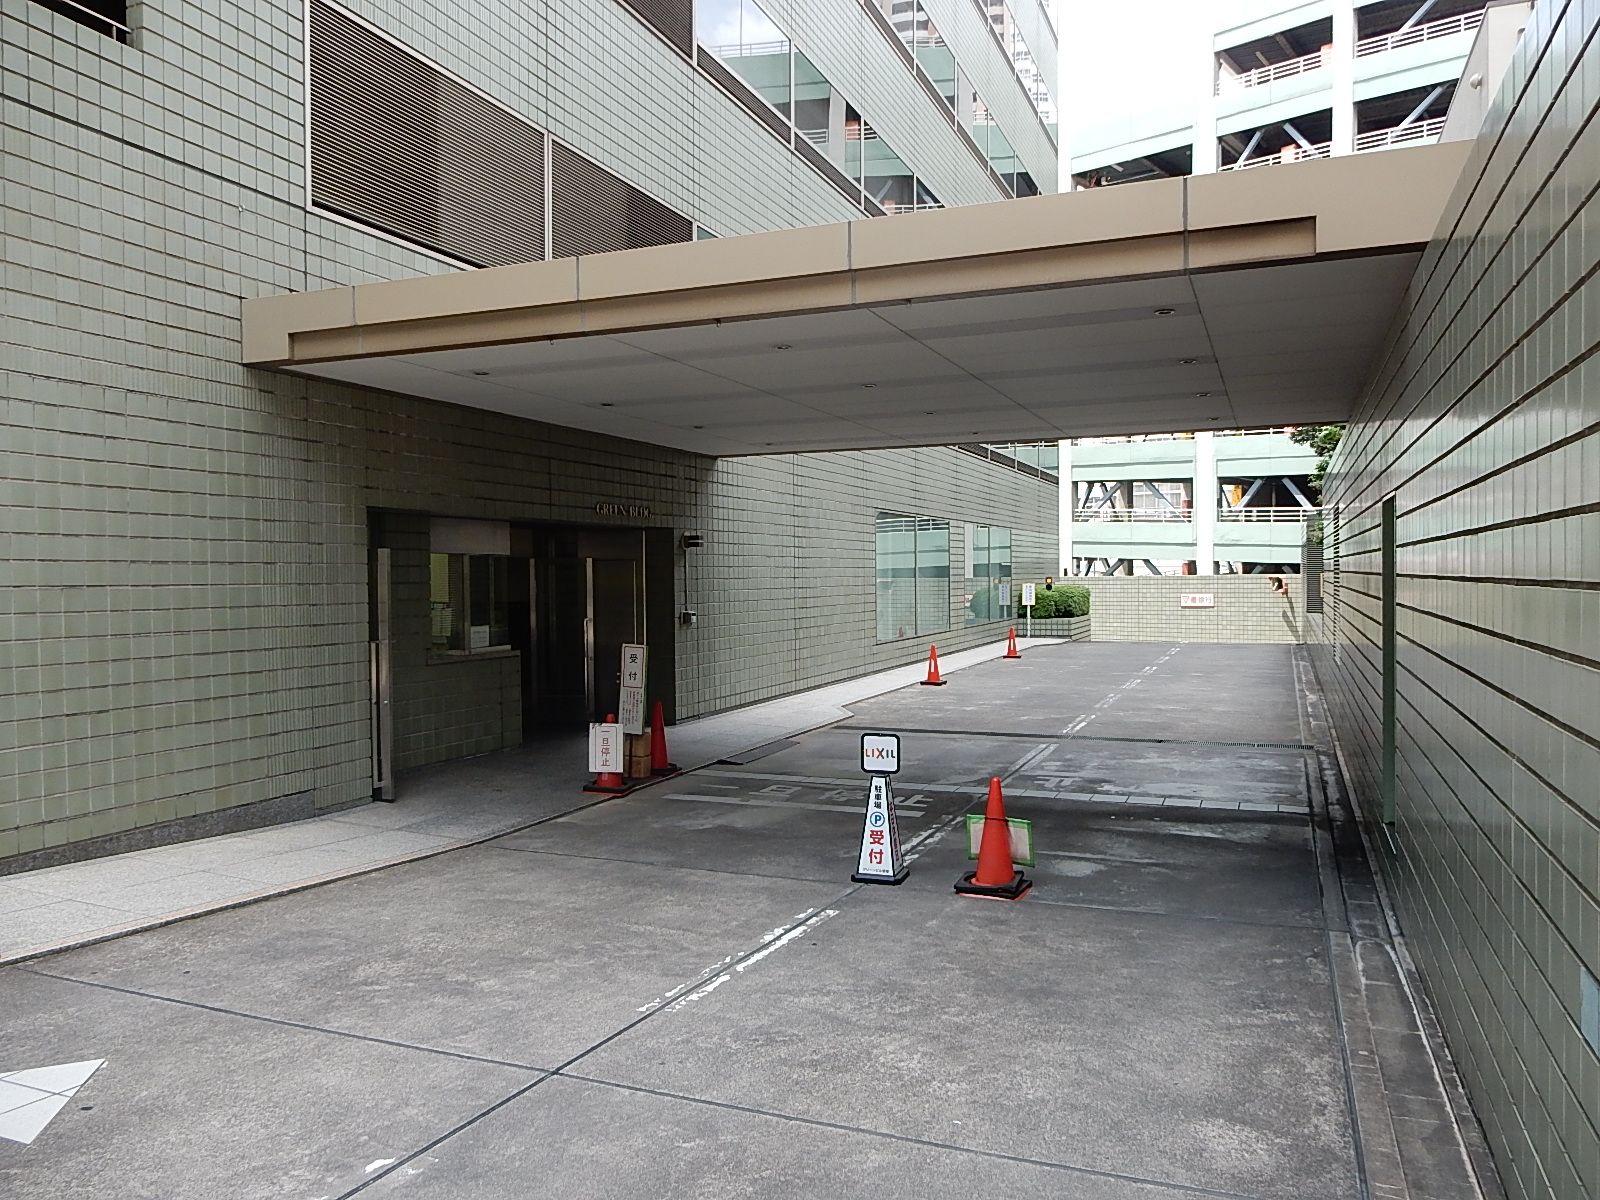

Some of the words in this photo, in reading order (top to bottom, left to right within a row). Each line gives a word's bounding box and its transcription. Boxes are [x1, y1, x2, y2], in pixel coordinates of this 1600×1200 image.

[628, 653, 638, 681] 受付
[600, 730, 611, 767] 一旦停止
[865, 747, 896, 760] LIXIL
[873, 785, 883, 809] 駐車場
[869, 829, 885, 864] 受付
